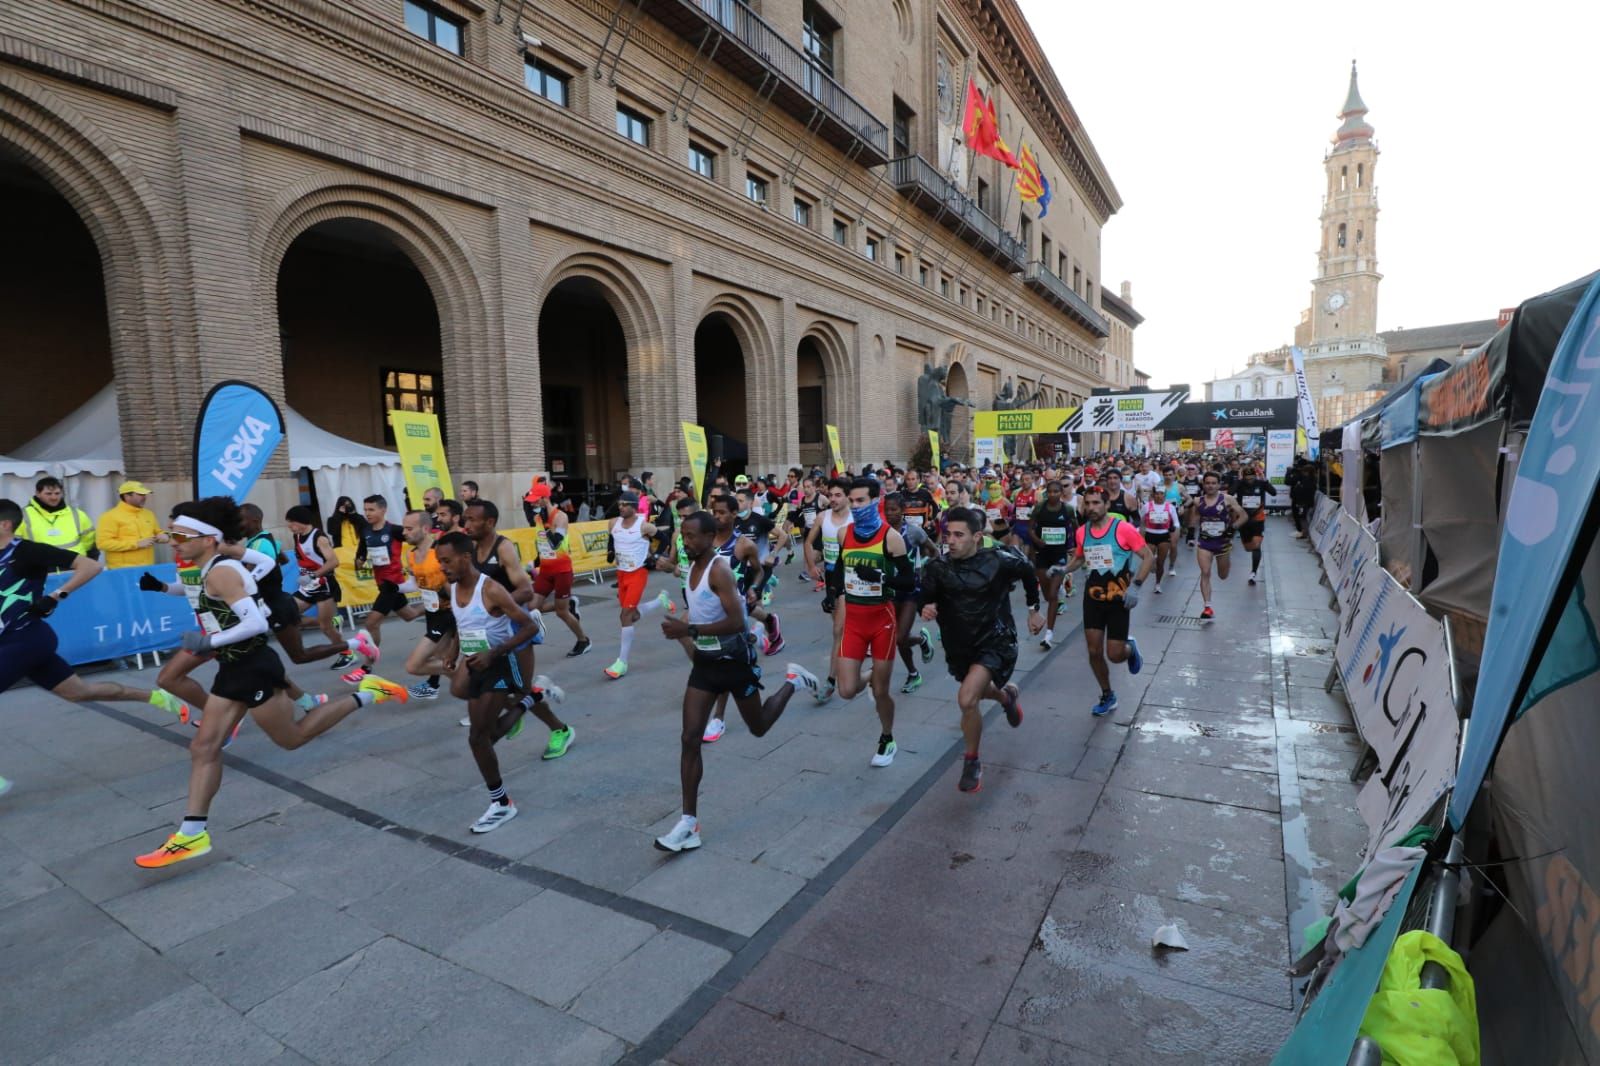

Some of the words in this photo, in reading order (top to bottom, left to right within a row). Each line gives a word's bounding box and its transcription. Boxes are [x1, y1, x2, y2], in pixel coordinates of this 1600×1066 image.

[1229, 408, 1275, 417] CaixaBank
[1000, 414, 1031, 422] MANN
[1000, 422, 1031, 430] FILTER
[211, 415, 271, 490] HOKA
[94, 616, 172, 642] TIME
